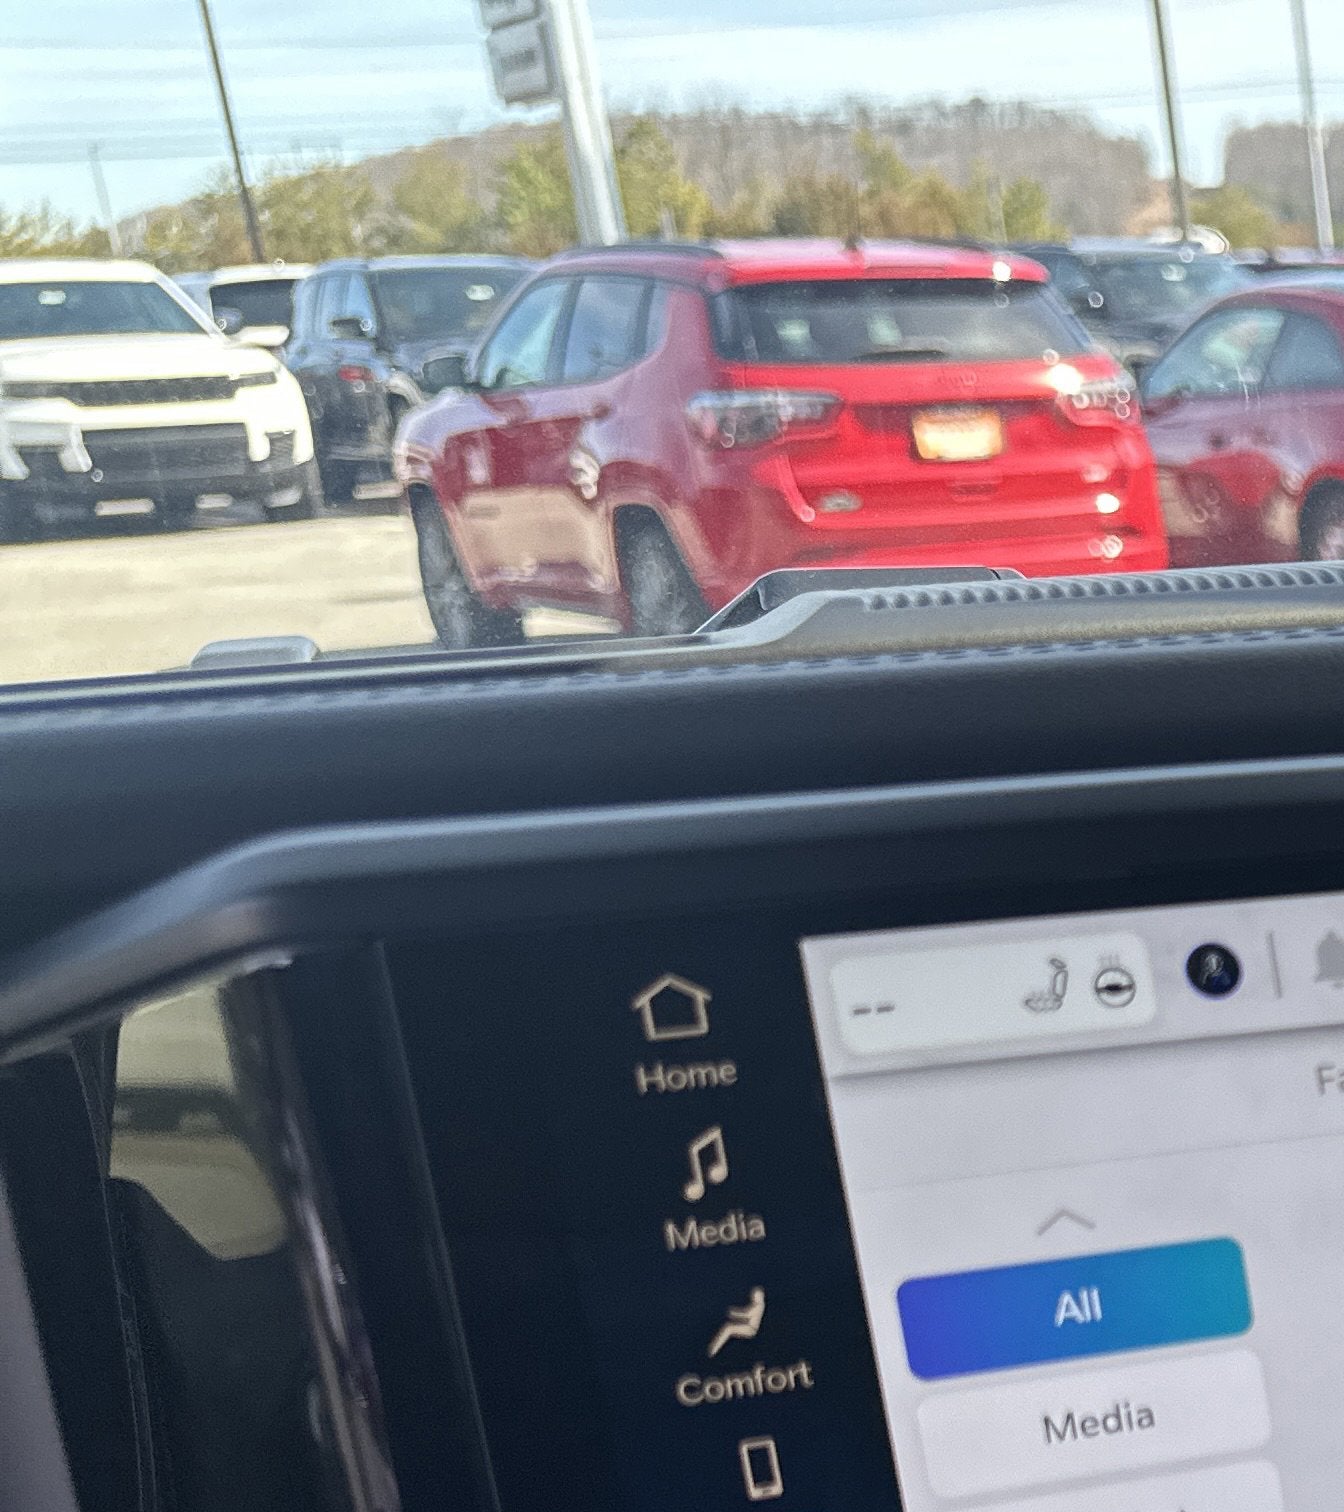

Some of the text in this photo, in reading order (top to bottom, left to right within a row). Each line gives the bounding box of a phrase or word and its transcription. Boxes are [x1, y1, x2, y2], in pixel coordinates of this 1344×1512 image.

[634, 1060, 738, 1095] Home
[663, 1212, 766, 1251] Media
[1054, 1288, 1102, 1328] All
[675, 1362, 814, 1407] Comfort
[1041, 1402, 1155, 1445] Media
